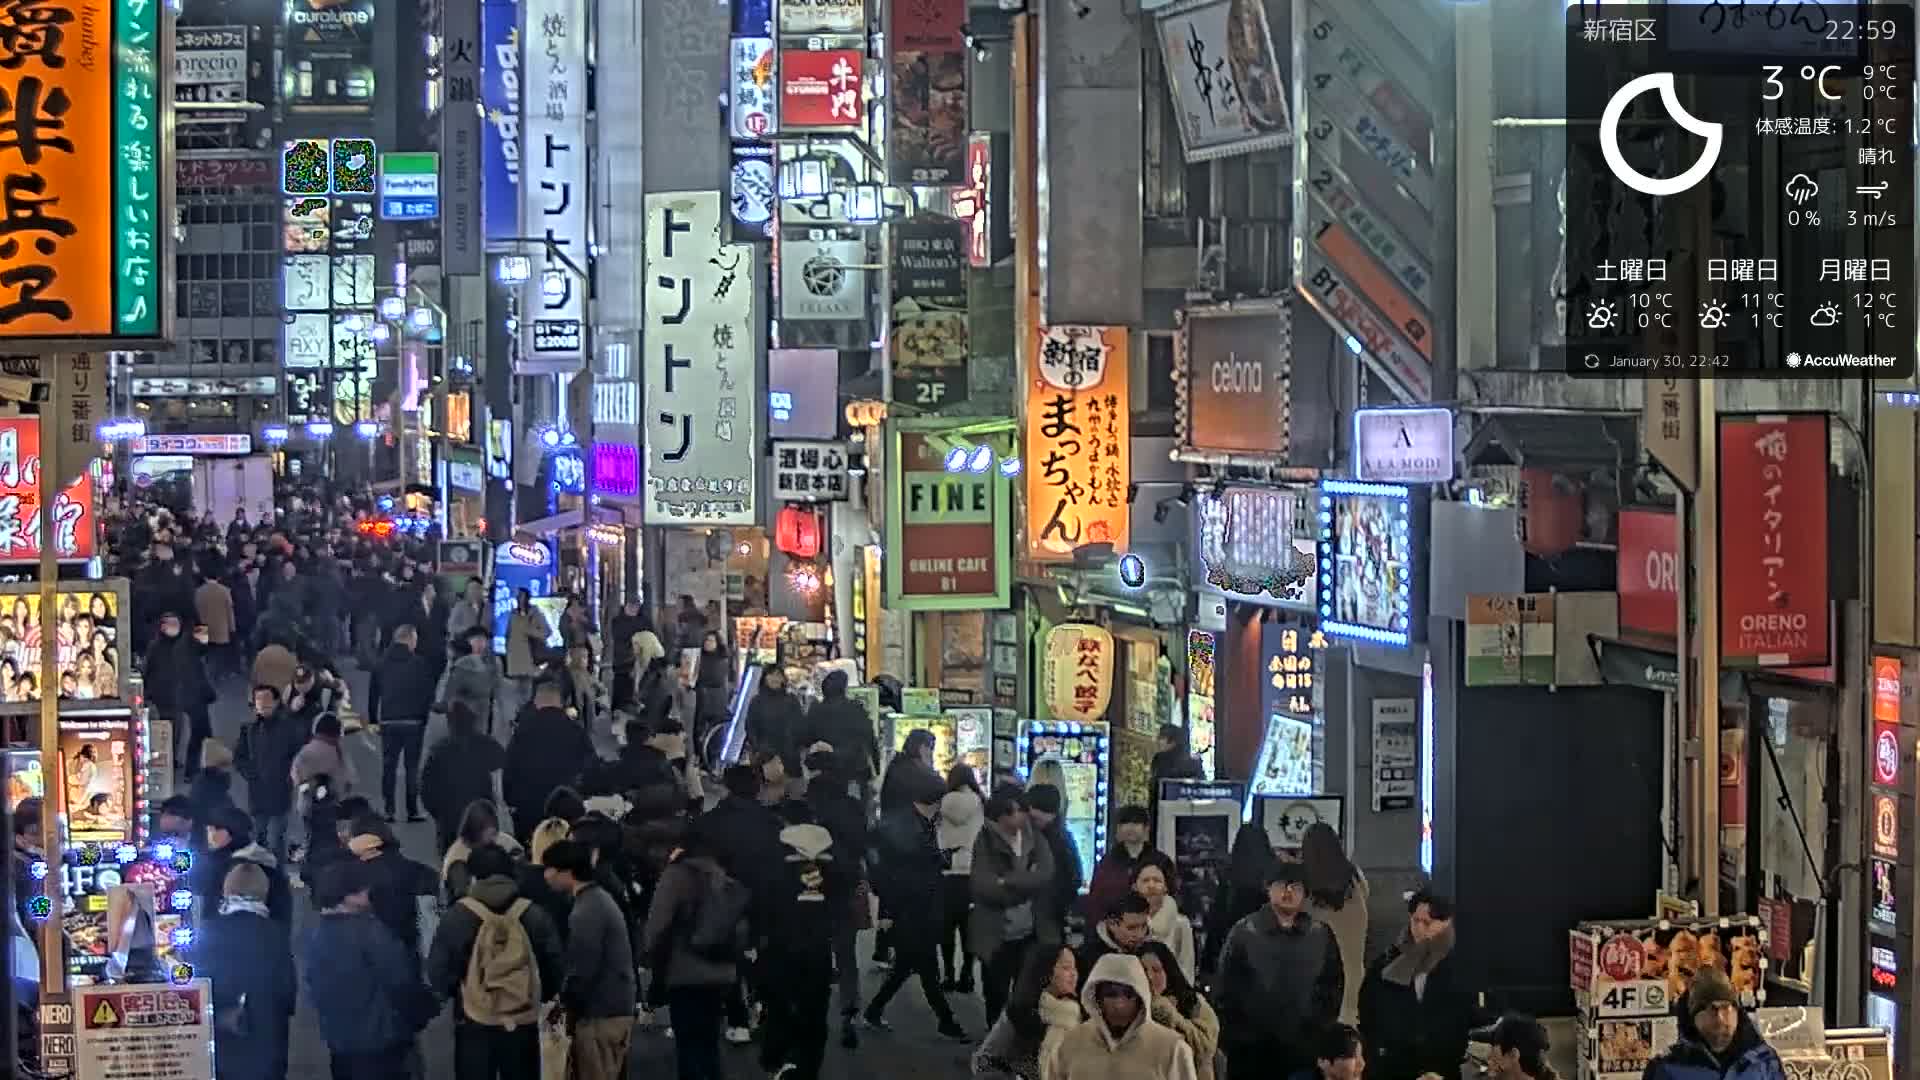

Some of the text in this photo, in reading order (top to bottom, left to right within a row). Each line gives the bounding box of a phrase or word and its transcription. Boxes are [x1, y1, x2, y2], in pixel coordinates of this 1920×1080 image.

[1312, 20, 1334, 41] 5
[1313, 72, 1333, 89] 4
[1313, 119, 1334, 141] 3
[1312, 170, 1333, 192] 2
[1311, 267, 1339, 296] B1
[657, 208, 691, 462] トントン
[1212, 352, 1262, 394] celona
[71, 353, 91, 444] 通り一番街
[916, 383, 946, 403] 2F
[778, 449, 844, 469] 酒場心
[1040, 395, 1085, 545] まっちゃん
[778, 472, 844, 492] 新宿本店
[911, 484, 987, 512] FINE
[1754, 428, 1788, 602] 俺のイタリアン
[909, 559, 988, 575] ONLINE CAFE
[1740, 614, 1807, 630] ORENO
[1739, 632, 1808, 649] ITALIAN
[1602, 987, 1637, 1009] 4F
[41, 1004, 73, 1024] NERO
[43, 1035, 74, 1055] NERO
